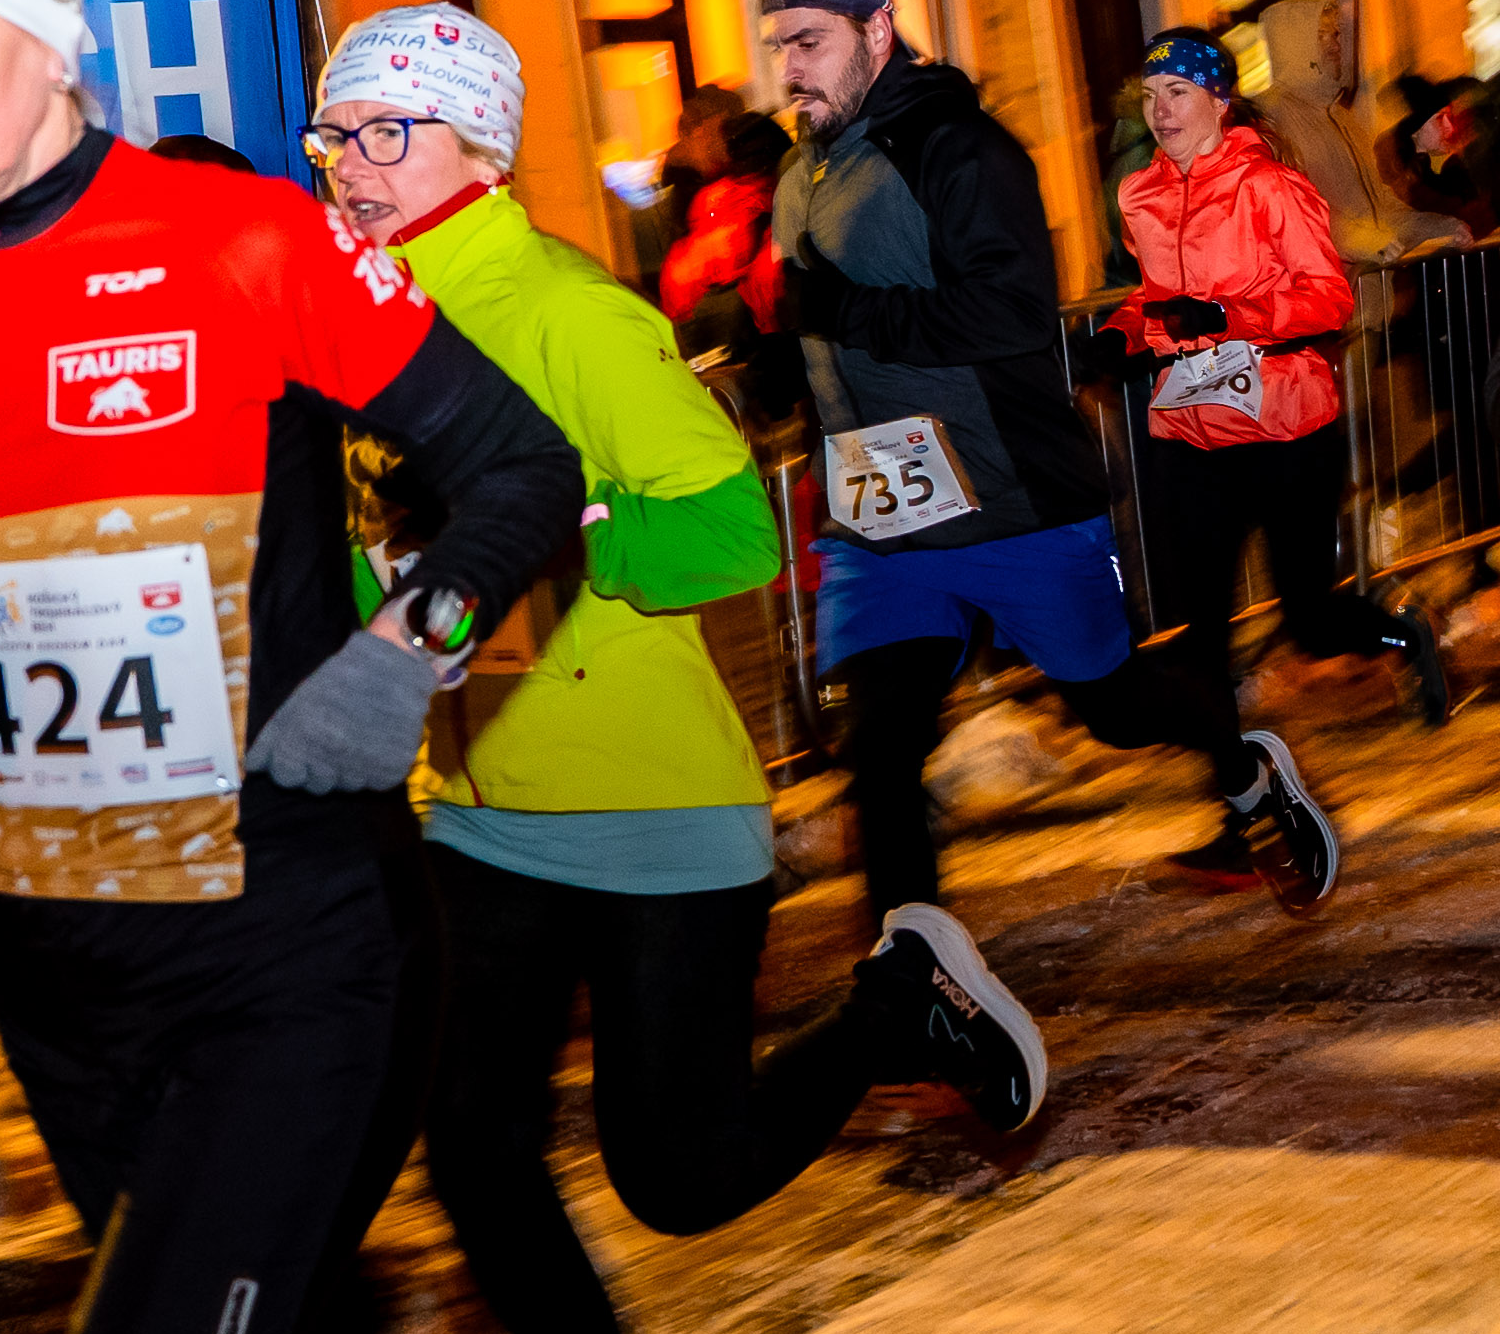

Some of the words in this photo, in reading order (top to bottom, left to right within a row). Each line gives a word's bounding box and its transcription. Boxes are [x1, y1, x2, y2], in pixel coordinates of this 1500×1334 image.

[344, 32, 425, 52] VAKIA
[412, 60, 491, 98] SLOVAKIA
[86, 267, 166, 297] TOP
[56, 342, 183, 383] TAURIS
[846, 459, 934, 521] 735
[932, 966, 980, 1019] HOKA
